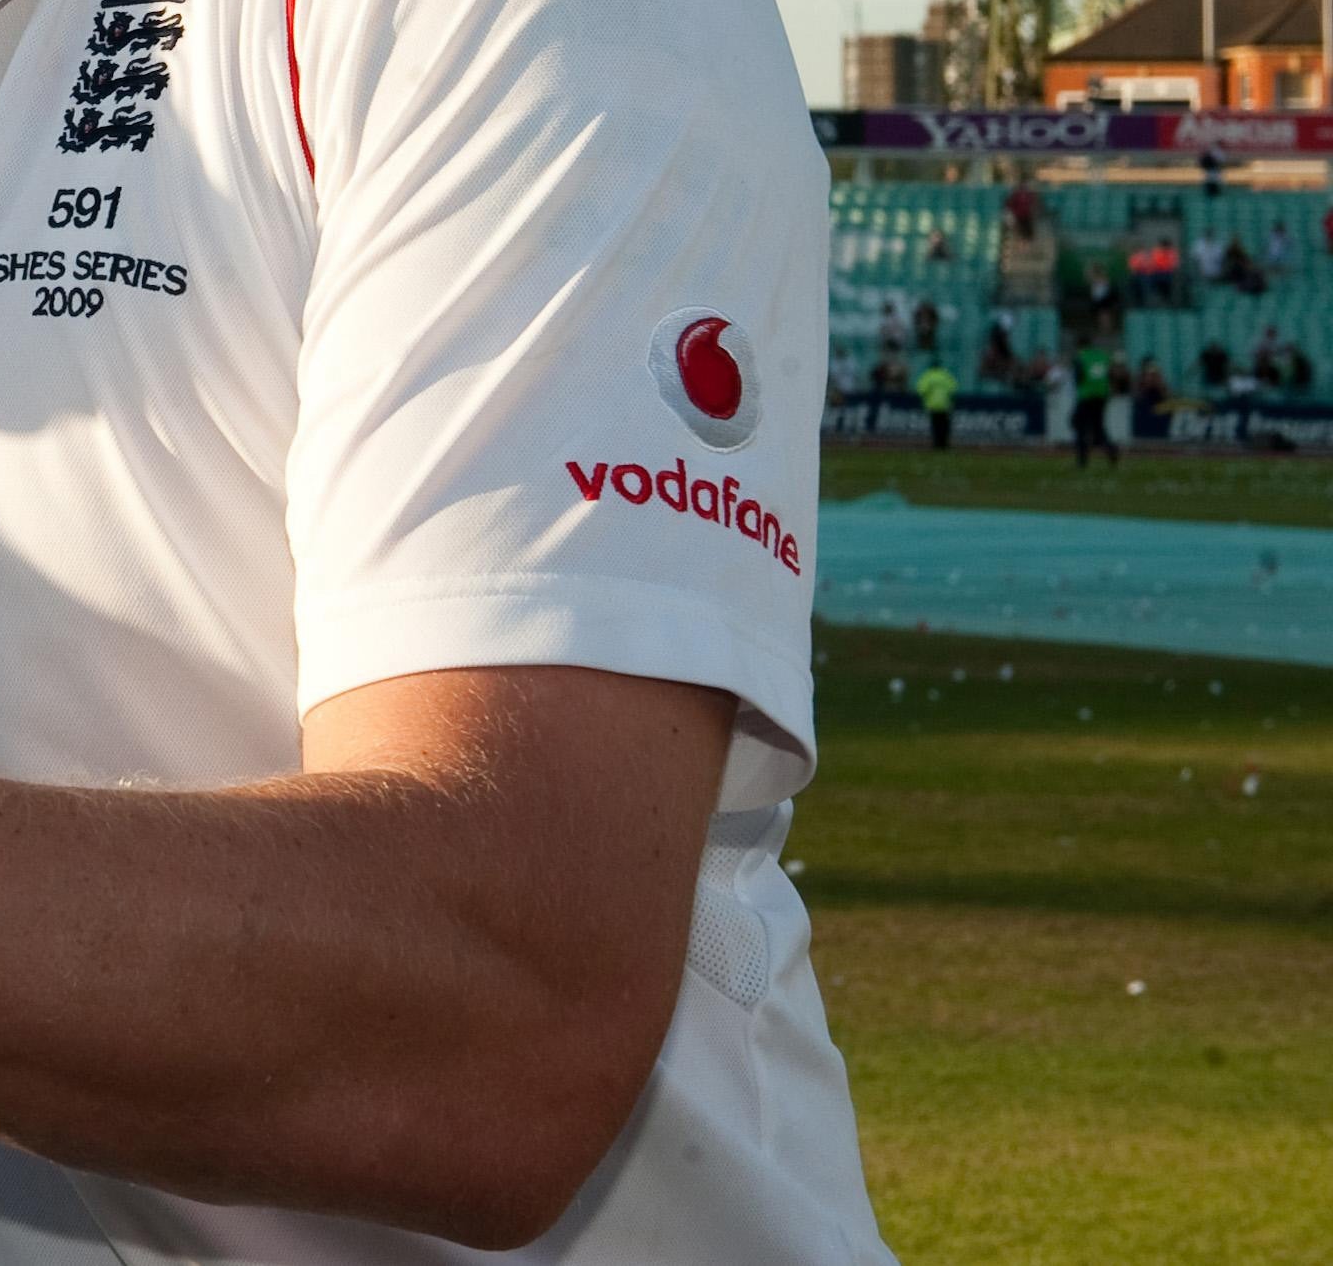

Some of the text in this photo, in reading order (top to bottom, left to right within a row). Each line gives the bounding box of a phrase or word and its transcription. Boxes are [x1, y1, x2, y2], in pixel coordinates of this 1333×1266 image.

[47, 186, 122, 229] 591
[73, 250, 187, 295] SERIES
[32, 286, 104, 317] 2009
